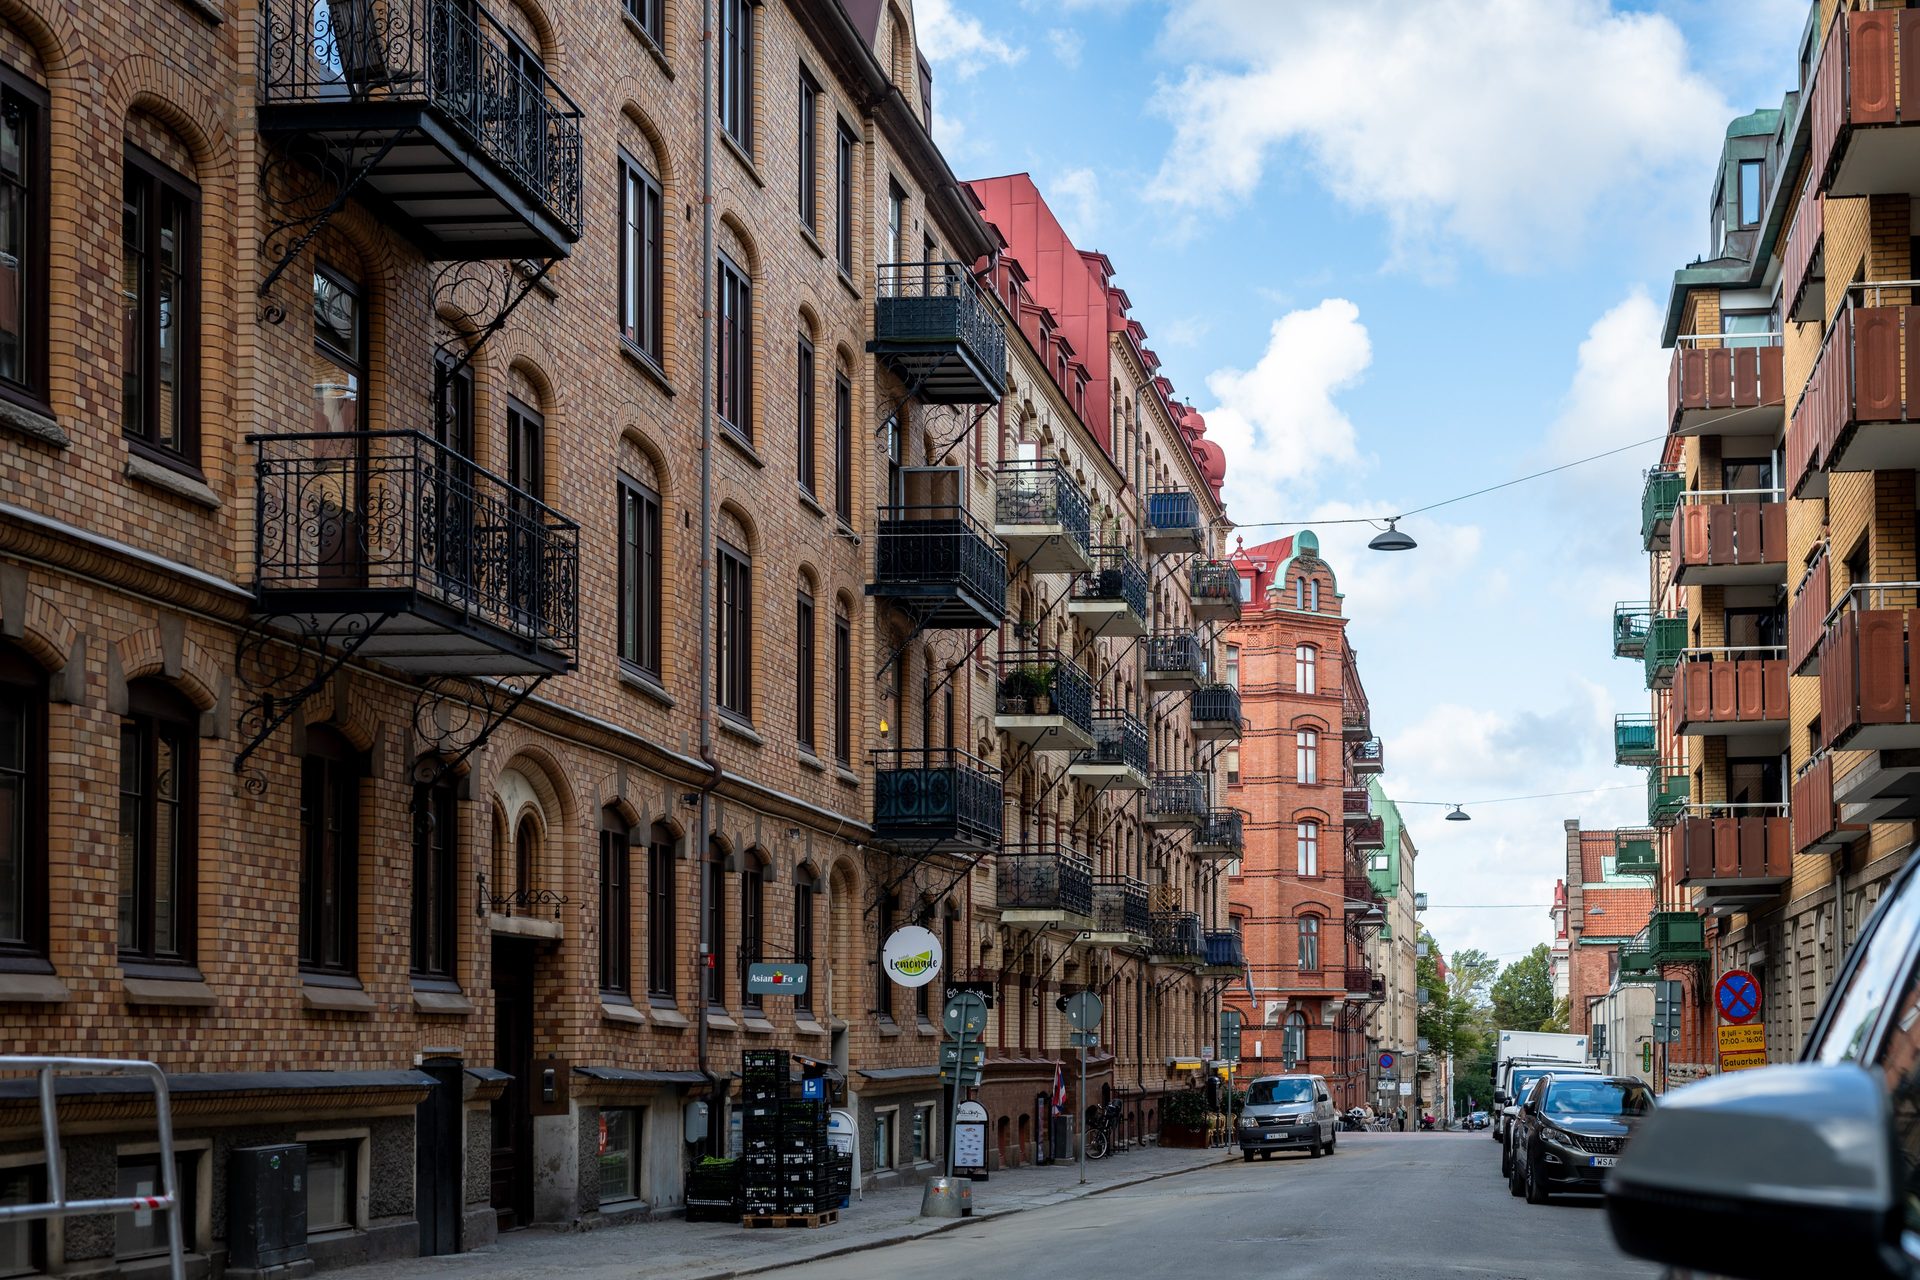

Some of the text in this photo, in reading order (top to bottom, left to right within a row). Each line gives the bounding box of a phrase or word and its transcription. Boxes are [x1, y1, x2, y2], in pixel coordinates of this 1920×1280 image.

[890, 958, 938, 970] Lemonade
[750, 974, 804, 983] Asian Food
[1727, 1030, 1737, 1038] juli
[1724, 1058, 1764, 1066] Gatuarbete
[1597, 1158, 1613, 1166] WSA
